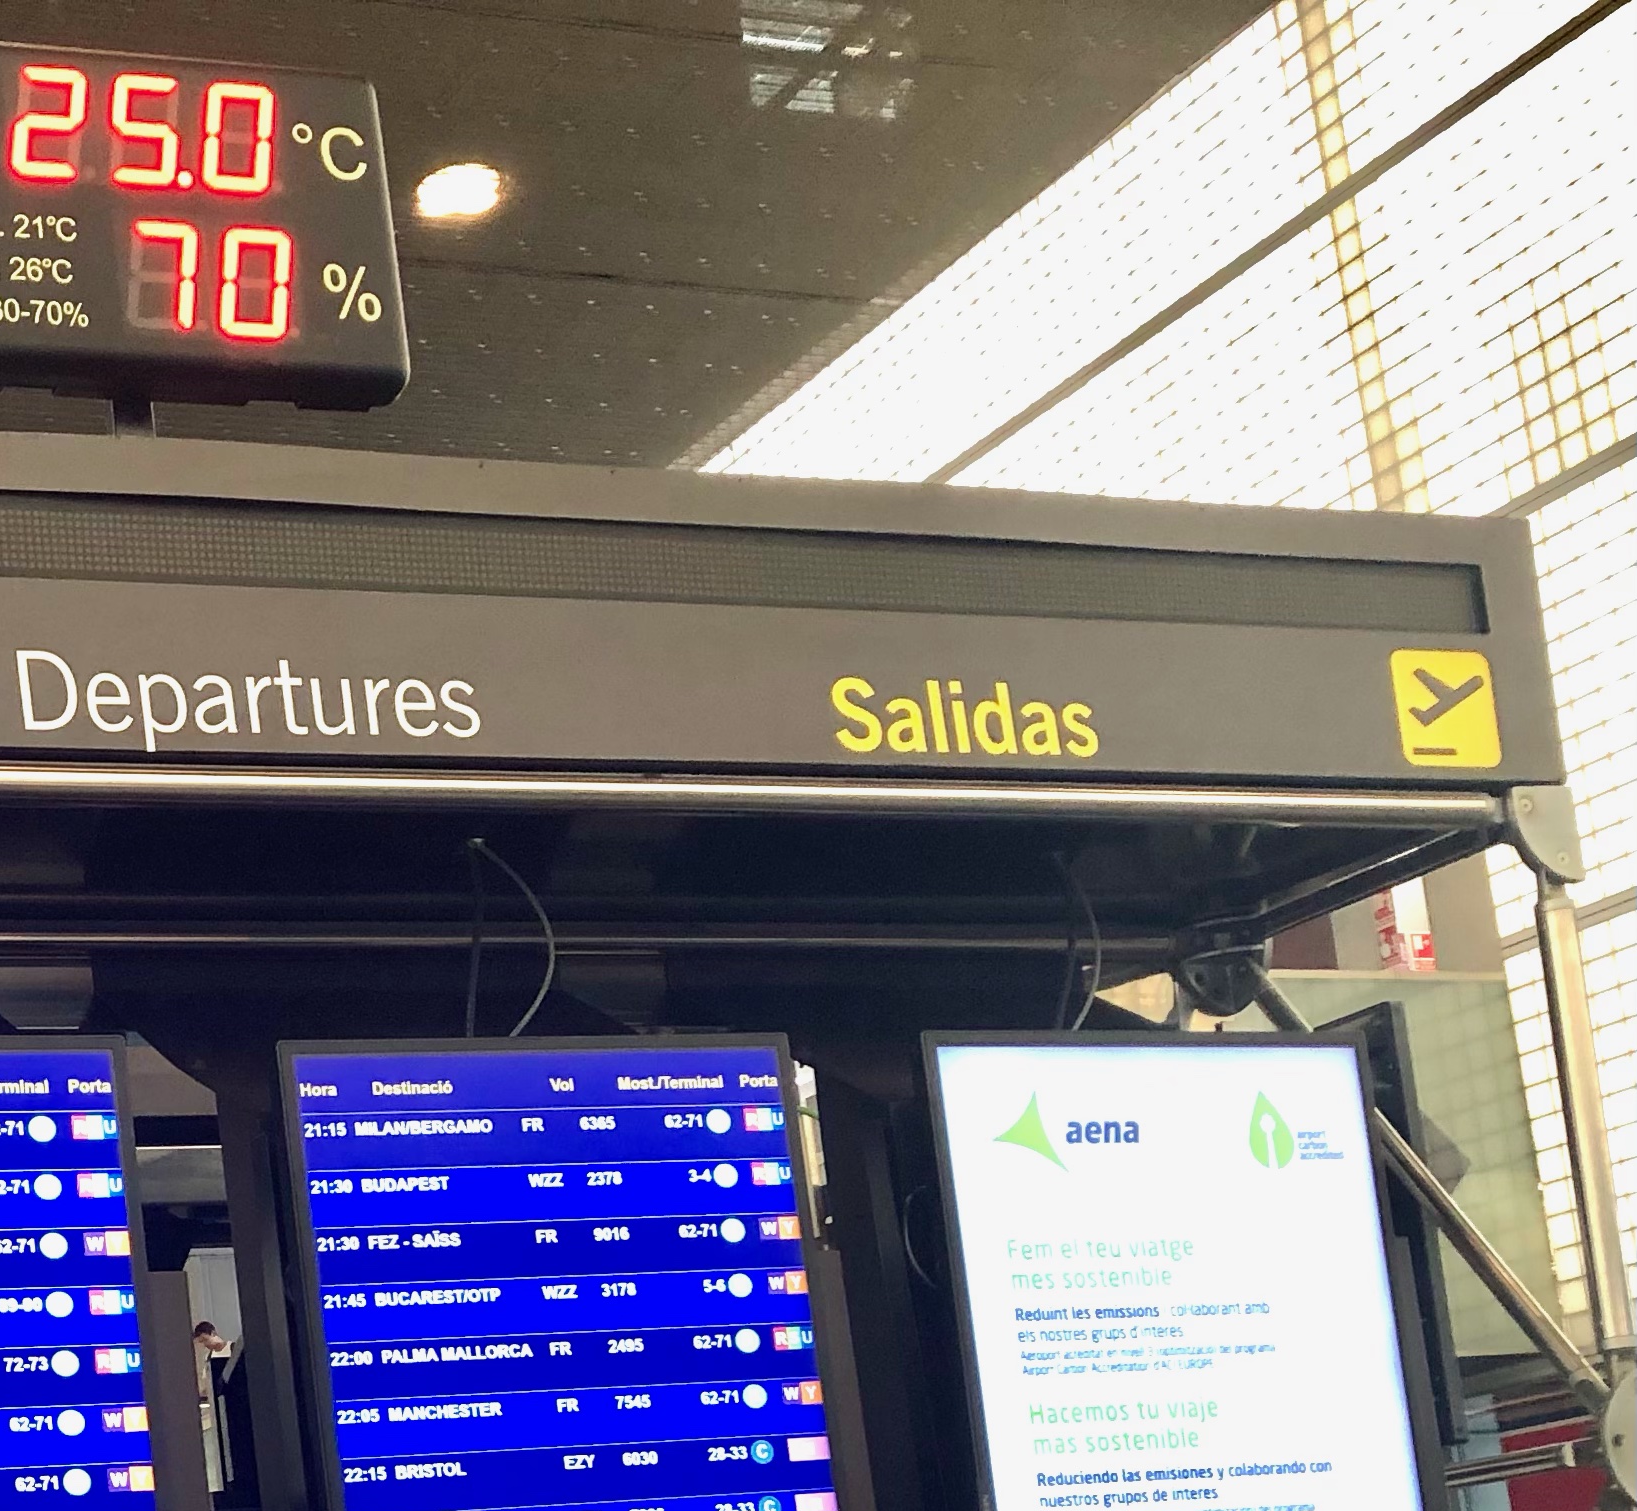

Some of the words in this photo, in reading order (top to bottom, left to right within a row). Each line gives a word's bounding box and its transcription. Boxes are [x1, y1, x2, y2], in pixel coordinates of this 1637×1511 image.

[9, 63, 276, 195] 25.0
[132, 218, 294, 340] 70
[322, 262, 384, 324] %
[14, 647, 482, 754] Departures
[830, 675, 1100, 759] Salidas
[67, 1078, 113, 1094] Porta
[298, 1082, 338, 1098] Hora
[371, 1079, 454, 1096] Destinació
[548, 1077, 575, 1092] Vol
[738, 1073, 779, 1088] Porta
[303, 1121, 347, 1138] 21:15
[353, 1118, 494, 1137] MILAN/BERGAMO
[1066, 1121, 1139, 1144] aena
[310, 1178, 354, 1195] 21:30
[360, 1175, 450, 1193] BUDAPEST
[316, 1235, 360, 1252] 21:30
[367, 1234, 401, 1250] FEZ
[323, 1292, 367, 1310] 21:45
[374, 1287, 502, 1307] BUCAREST/OTP
[1015, 1308, 1068, 1321] Reduint
[1072, 1308, 1091, 1319] les
[1095, 1306, 1159, 1319] emissions
[2, 1355, 50, 1373] 72-73
[329, 1350, 374, 1367] 22:00
[380, 1347, 440, 1364] PALMA
[440, 1343, 534, 1362] MALLORCA
[336, 1408, 381, 1425] 22:05
[387, 1401, 503, 1422] MANCHESTER
[614, 1393, 652, 1410] 7545
[1030, 1405, 1129, 1424] Hacemos
[1138, 1403, 1159, 1419] tu
[1086, 1429, 1198, 1453] sostenible
[343, 1465, 388, 1483] 22:15
[394, 1461, 468, 1480] BRISTOL
[1037, 1471, 1118, 1486] Reduciendo
[1122, 1470, 1141, 1482] las
[1146, 1468, 1213, 1481] emisiones
[1217, 1469, 1224, 1481] y
[1229, 1461, 1306, 1477] colaborando
[1310, 1462, 1332, 1473] con
[1040, 1495, 1099, 1507] nuestros
[1104, 1493, 1148, 1508] grupos
[1153, 1490, 1168, 1502] de
